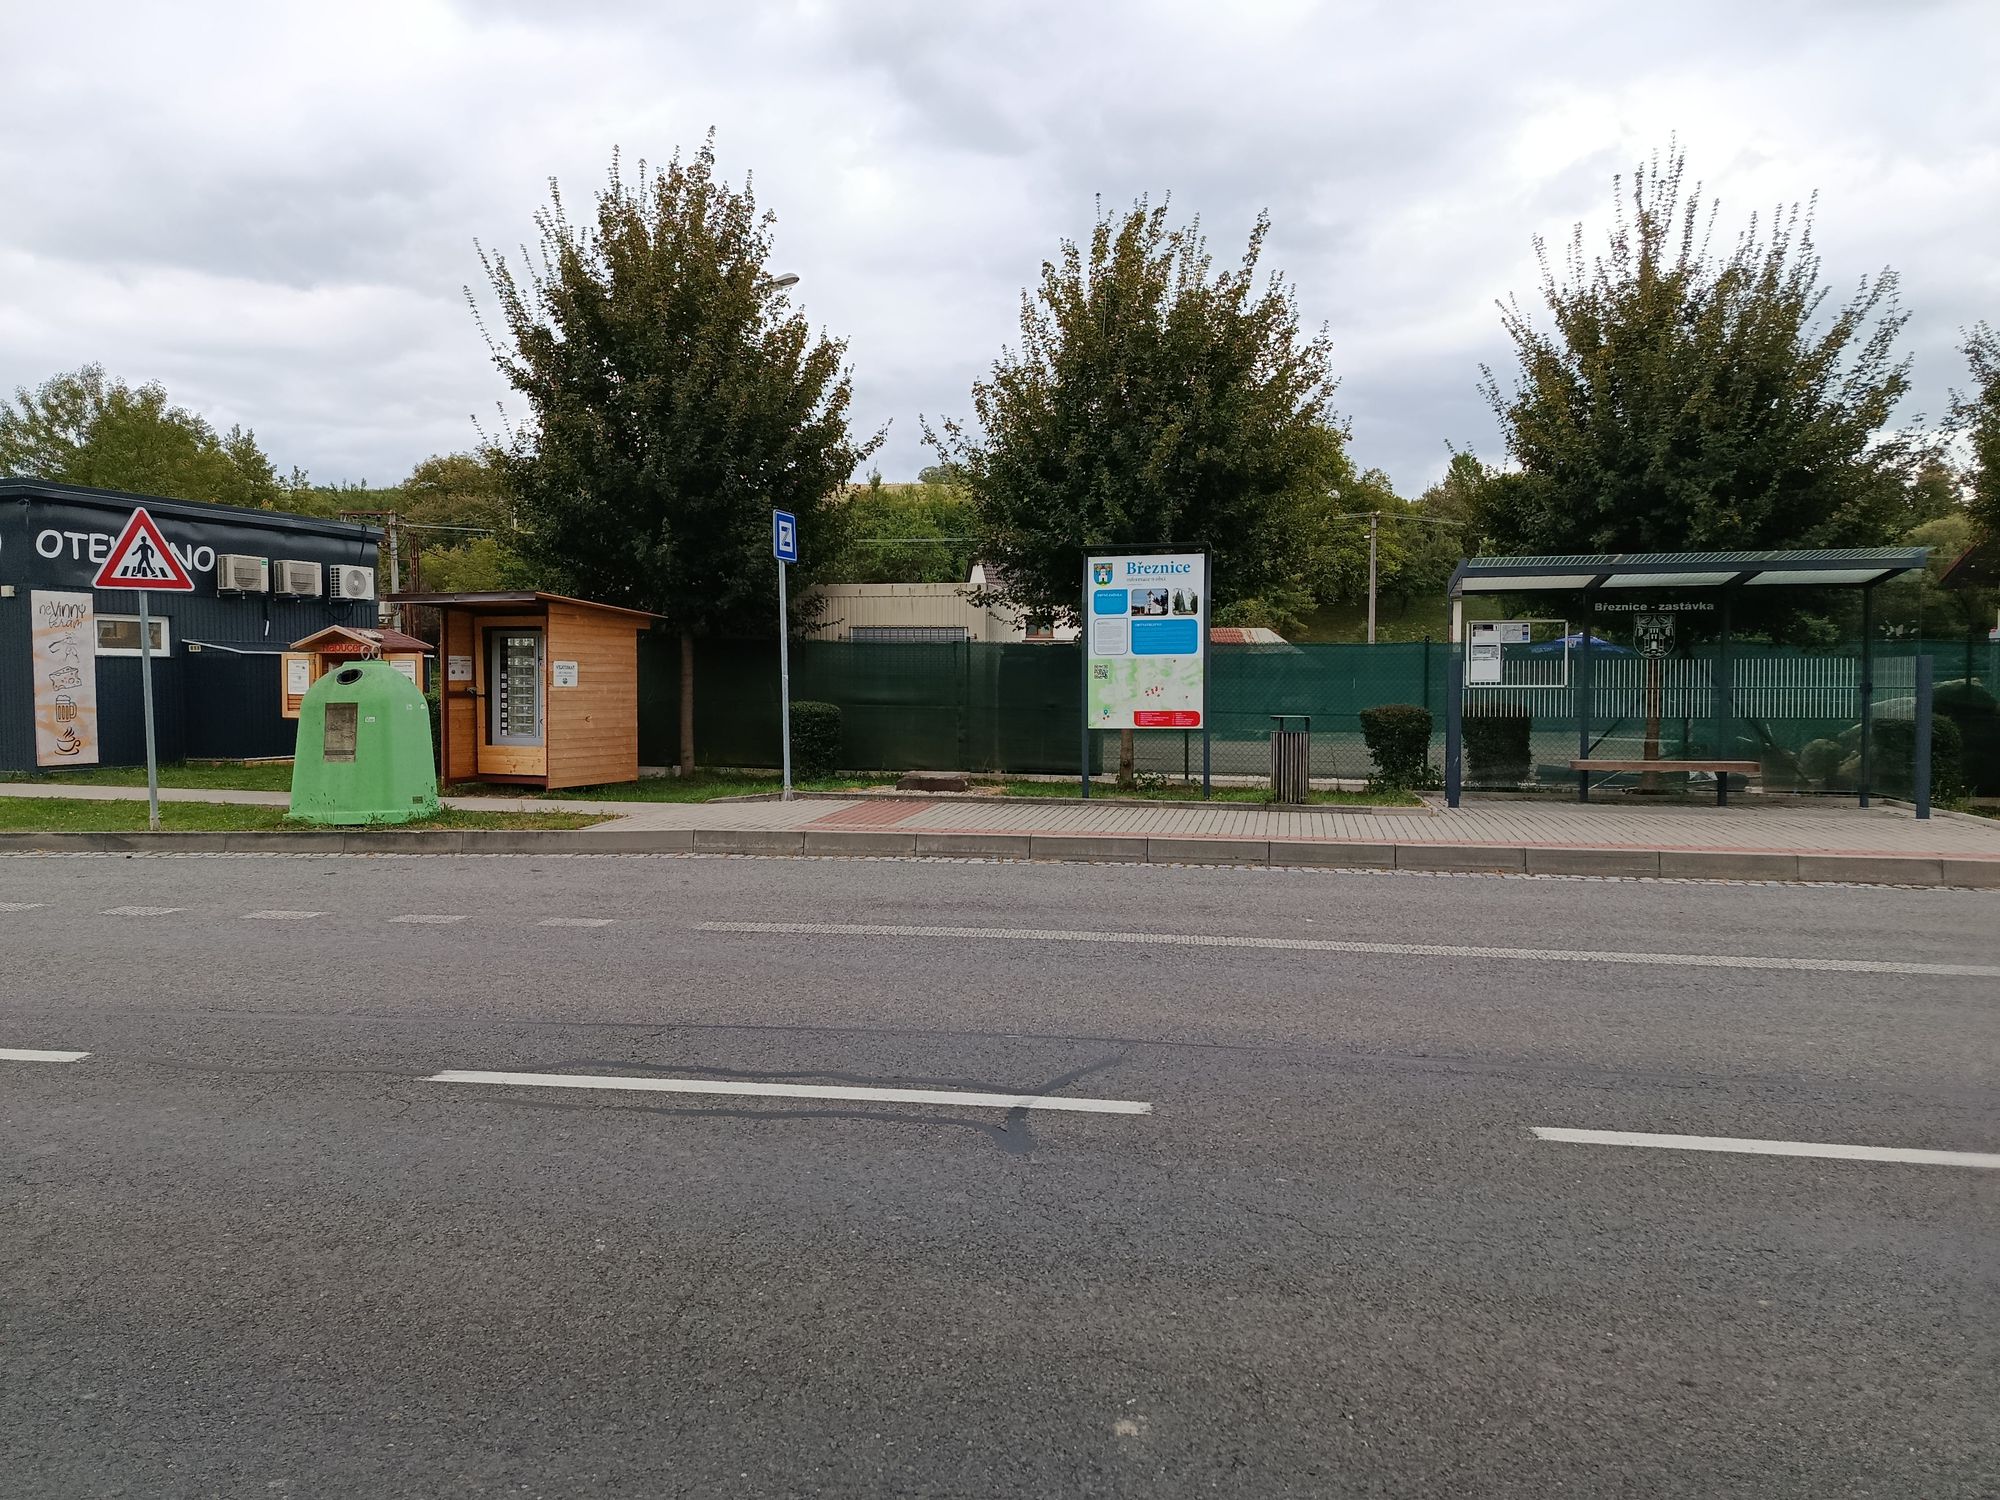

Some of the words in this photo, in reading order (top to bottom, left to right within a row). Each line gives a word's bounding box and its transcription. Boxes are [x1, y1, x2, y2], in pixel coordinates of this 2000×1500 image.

[36, 529, 215, 572] OTENO
[1126, 561, 1191, 575] Březnice
[1594, 602, 1648, 612] Březnice
[1658, 601, 1715, 611] zastávka
